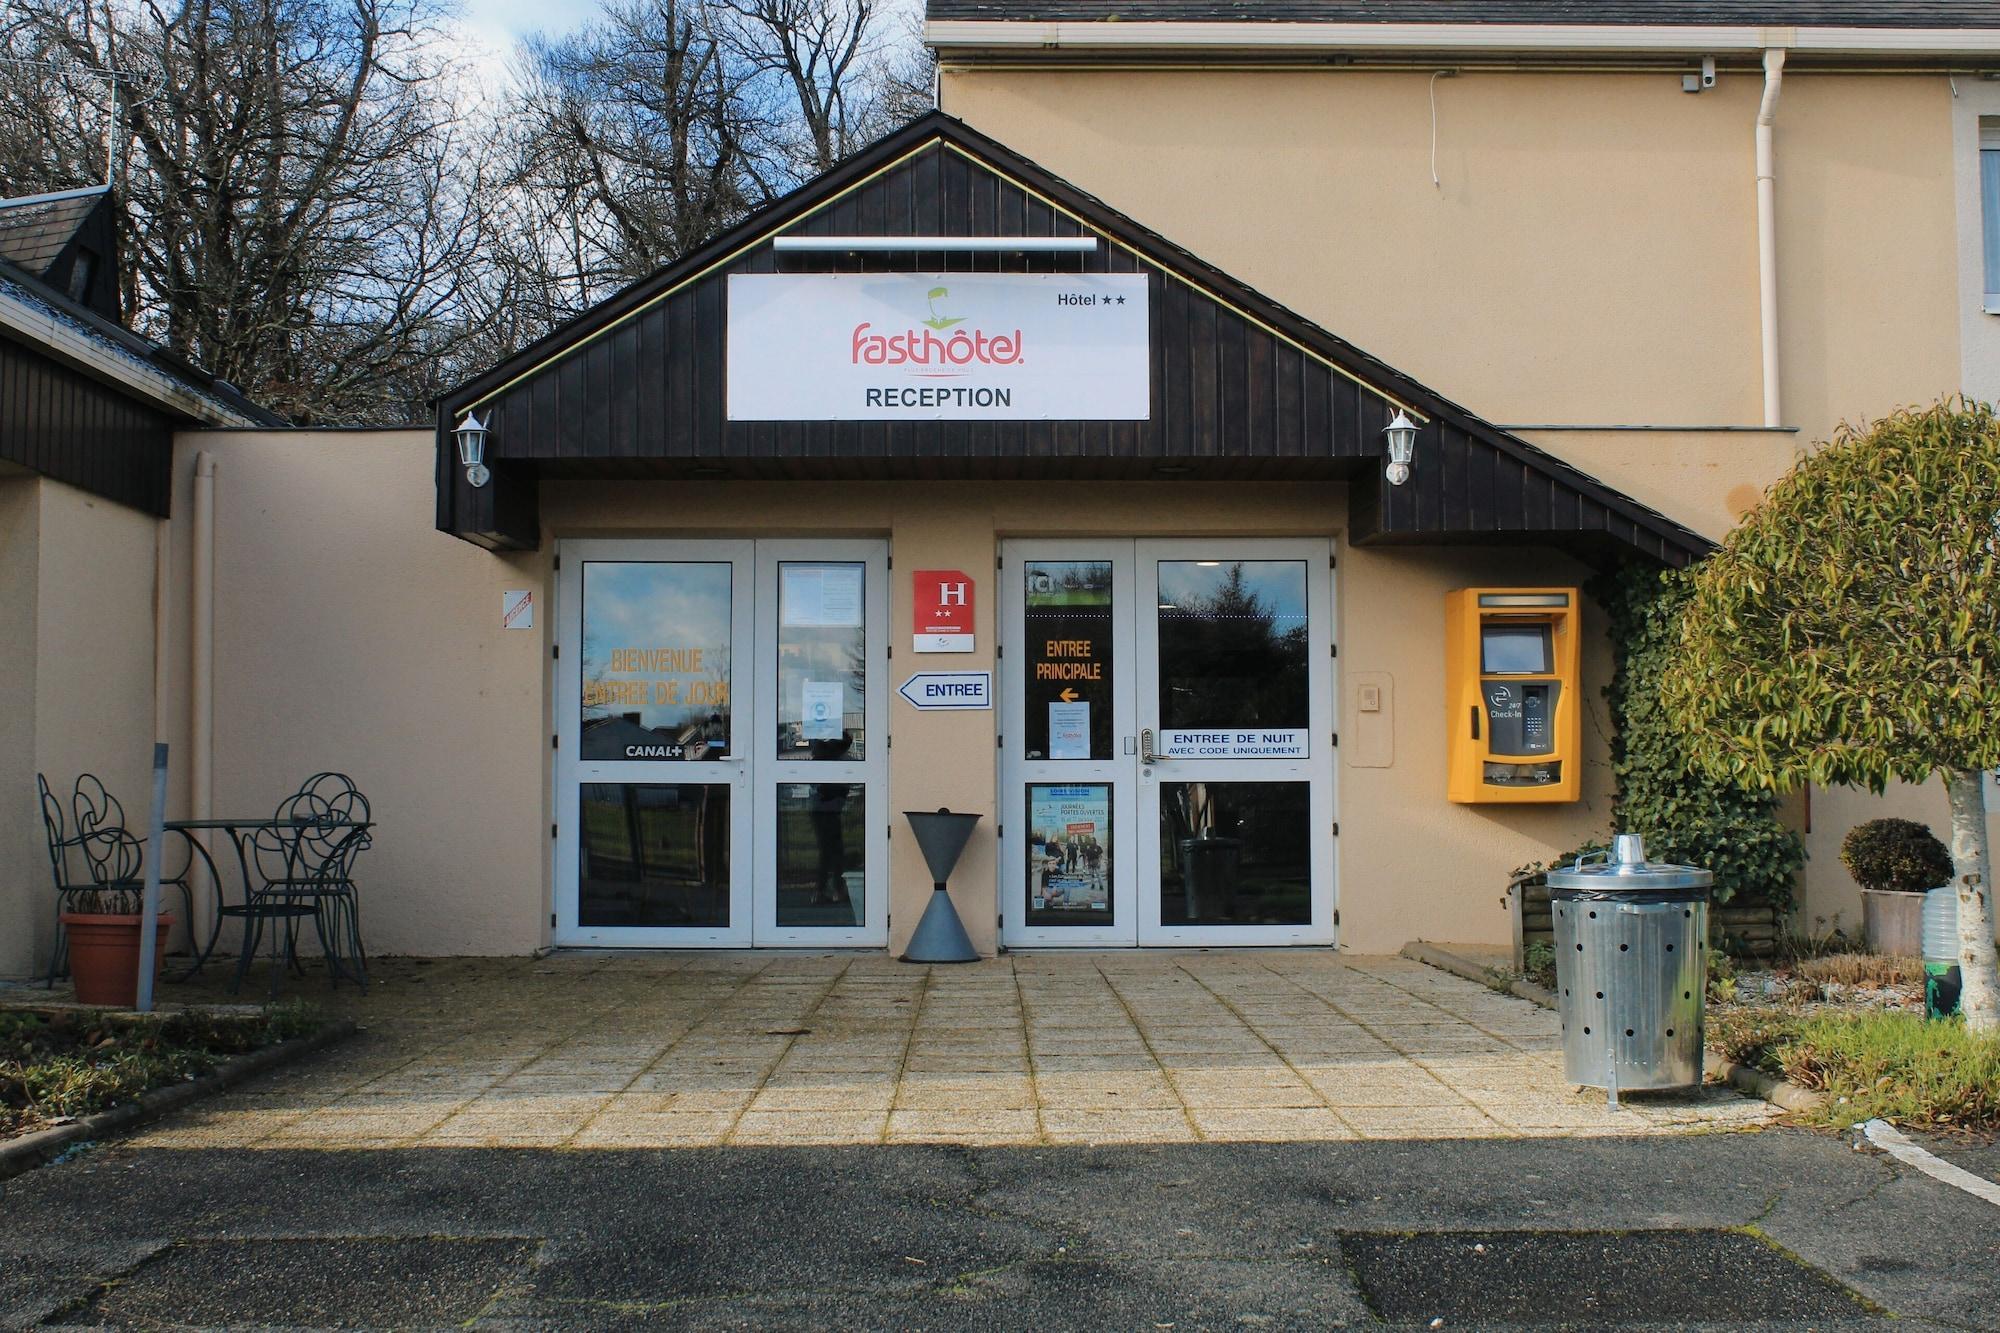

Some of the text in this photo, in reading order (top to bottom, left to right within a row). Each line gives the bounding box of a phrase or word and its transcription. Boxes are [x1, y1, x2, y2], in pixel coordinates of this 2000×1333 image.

[1058, 293, 1096, 306] Hôtel
[866, 388, 1011, 407] RECEPTION
[938, 582, 968, 606] H
[1046, 640, 1092, 657] ENTREE
[611, 648, 704, 673] BIENVENUE
[1036, 663, 1101, 680] PRINCIPALE
[583, 681, 729, 705] ENTREE DE JOUR
[926, 684, 983, 697] ENTREE
[1173, 734, 1295, 744] ENTREE DE NUIT
[625, 745, 683, 757] CANAL+
[1168, 746, 1302, 755] AVEC CODE UNIQUEMENT
